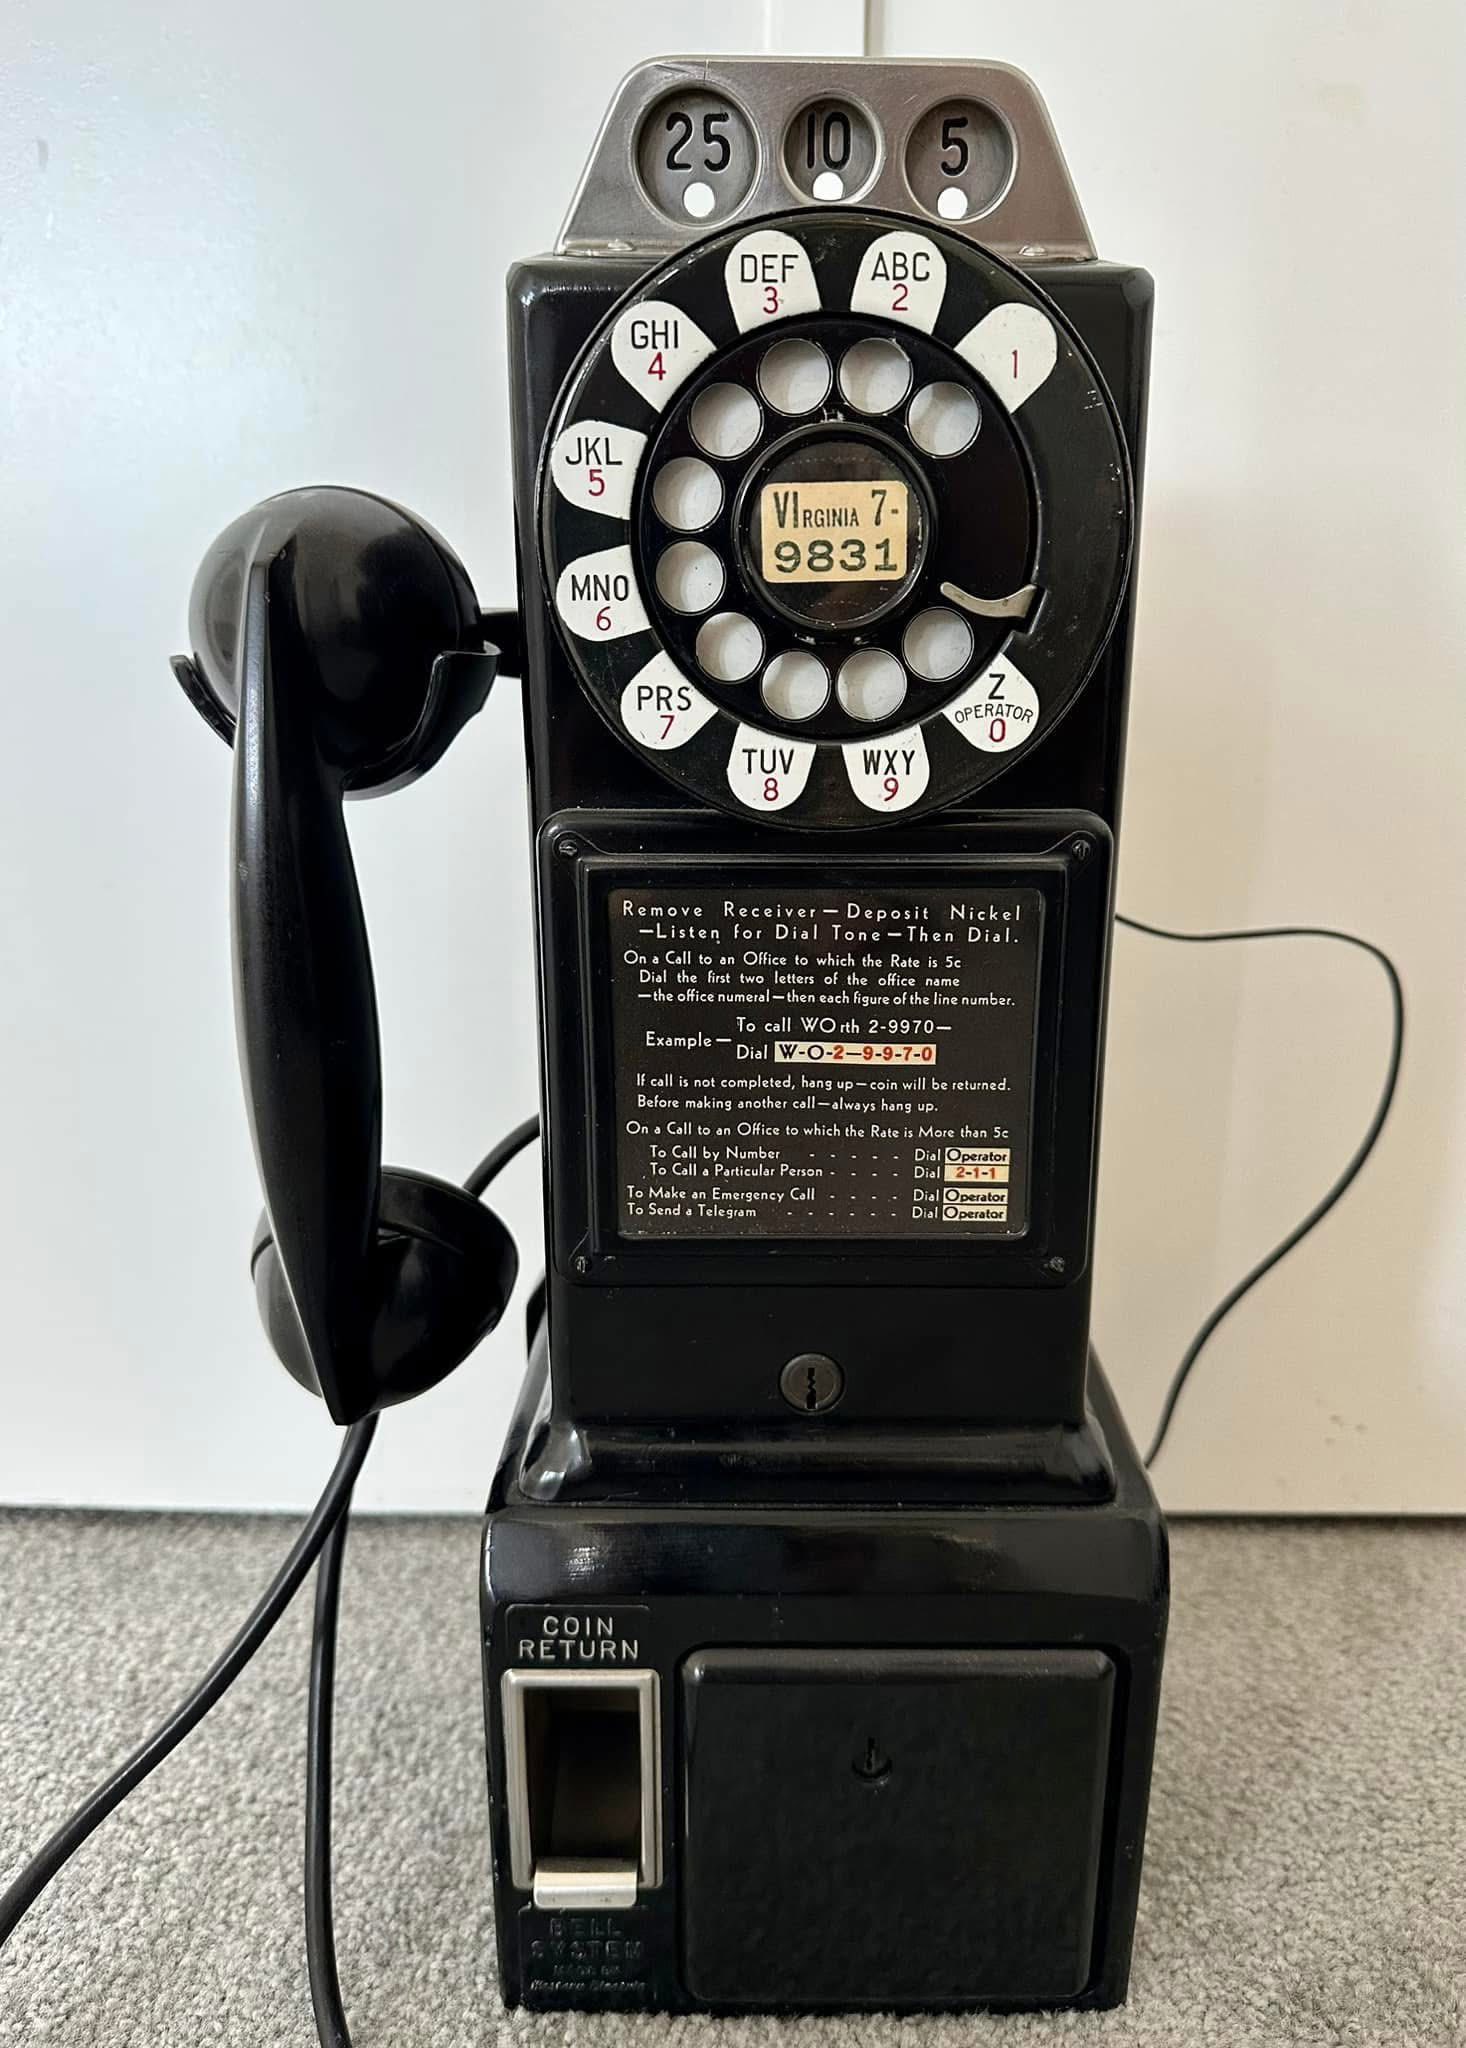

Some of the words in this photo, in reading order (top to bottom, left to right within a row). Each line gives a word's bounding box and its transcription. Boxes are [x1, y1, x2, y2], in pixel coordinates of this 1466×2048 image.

[666, 111, 731, 171] 25
[806, 110, 851, 170] 10
[940, 116, 970, 175] 5
[741, 255, 798, 283] DEF
[871, 252, 929, 281] ABC
[763, 286, 778, 314] 3
[892, 283, 908, 311] 2
[631, 320, 678, 349] GHI
[648, 352, 666, 380] 4
[566, 438, 622, 465] JKL
[589, 469, 604, 496] 5
[774, 492, 859, 528] VIRGINIA
[775, 539, 897, 573] 9831
[572, 575, 628, 601] MNO
[597, 606, 611, 631] 6
[638, 686, 691, 711] PRS
[988, 673, 1006, 700] Z
[955, 704, 1033, 724] OPERATOR
[660, 715, 674, 739] 7
[988, 718, 1006, 743] 0
[742, 749, 794, 774] TUV
[864, 750, 915, 775] WXY
[764, 778, 778, 801] 8
[884, 778, 898, 801] 9
[622, 899, 703, 917] Remove
[950, 903, 1021, 921] Nickel
[733, 923, 762, 940] for
[775, 923, 818, 940] Dial
[967, 926, 1019, 943] Dial.
[623, 949, 647, 965] On
[651, 955, 660, 965] a
[665, 950, 691, 965] Call
[698, 953, 713, 966] to
[719, 956, 735, 966] an
[743, 950, 787, 966] Office
[794, 954, 809, 966] to
[816, 952, 855, 967] which
[861, 953, 883, 968] the
[890, 953, 921, 968] Rate
[927, 956, 938, 968] is
[945, 955, 962, 969] 5c
[639, 969, 667, 984] Dial
[676, 969, 698, 984] the
[707, 969, 731, 984] first
[739, 972, 765, 985] two
[774, 970, 815, 985] letters
[823, 971, 839, 985] of
[846, 971, 868, 986] the
[877, 972, 916, 987] office
[925, 977, 960, 987] name
[677, 988, 715, 1003] office
[819, 989, 850, 1004] each
[853, 990, 890, 1007] figure
[892, 991, 908, 1005] of
[909, 991, 930, 1006] the
[933, 991, 959, 1006] line
[961, 991, 1016, 1006] number.
[735, 1016, 756, 1033] To
[764, 1016, 792, 1033] call
[736, 1043, 768, 1060] Dial
[636, 1072, 646, 1087] If
[650, 1073, 673, 1088] call
[679, 1075, 689, 1088] is
[693, 1076, 716, 1088] not
[720, 1073, 796, 1091] completed,
[801, 1074, 833, 1092] hang
[902, 1076, 926, 1091] will
[931, 1076, 948, 1091] be
[952, 1077, 1011, 1091] returned.
[637, 1093, 680, 1109] Before
[685, 1095, 732, 1112] making
[737, 1095, 788, 1109] another
[881, 1097, 912, 1114] hang
[917, 1103, 939, 1114] up.
[625, 1120, 649, 1135] On
[653, 1126, 661, 1135] a
[666, 1121, 692, 1136] Call
[697, 1124, 711, 1136] to
[715, 1127, 731, 1136] an
[736, 1121, 780, 1136] Office
[785, 1125, 799, 1136] to
[803, 1122, 841, 1137] which
[844, 1123, 865, 1138] the
[870, 1124, 900, 1139] Rate
[903, 1129, 914, 1139] is
[918, 1125, 955, 1138] More
[960, 1124, 988, 1139] than
[993, 1126, 1009, 1139] 5c
[649, 1144, 667, 1159] To
[671, 1144, 697, 1159] Call
[702, 1145, 720, 1162] by
[726, 1145, 781, 1160] Number
[914, 1148, 941, 1162] Dial
[947, 1149, 1006, 1162] Operator
[649, 1162, 667, 1176] To
[671, 1162, 697, 1177] Call
[702, 1168, 710, 1177] a
[714, 1163, 776, 1177] Particular
[780, 1163, 823, 1177] Person
[913, 1165, 941, 1179] Dial
[956, 1167, 995, 1179] 2-1-1
[626, 1185, 644, 1199] To
[648, 1185, 687, 1199] Make
[691, 1191, 707, 1200] an
[712, 1186, 785, 1204] Emergency
[789, 1187, 815, 1201] Call
[913, 1188, 940, 1202] Dial
[946, 1189, 1005, 1202] Operator
[626, 1203, 644, 1216] To
[648, 1203, 681, 1216] Send
[685, 1208, 693, 1217] a
[697, 1203, 757, 1220] Telegram
[911, 1205, 939, 1219] Dial
[944, 1207, 1003, 1219] Operator
[544, 1616, 612, 1636] COIN
[520, 1640, 638, 1660] RETURN
